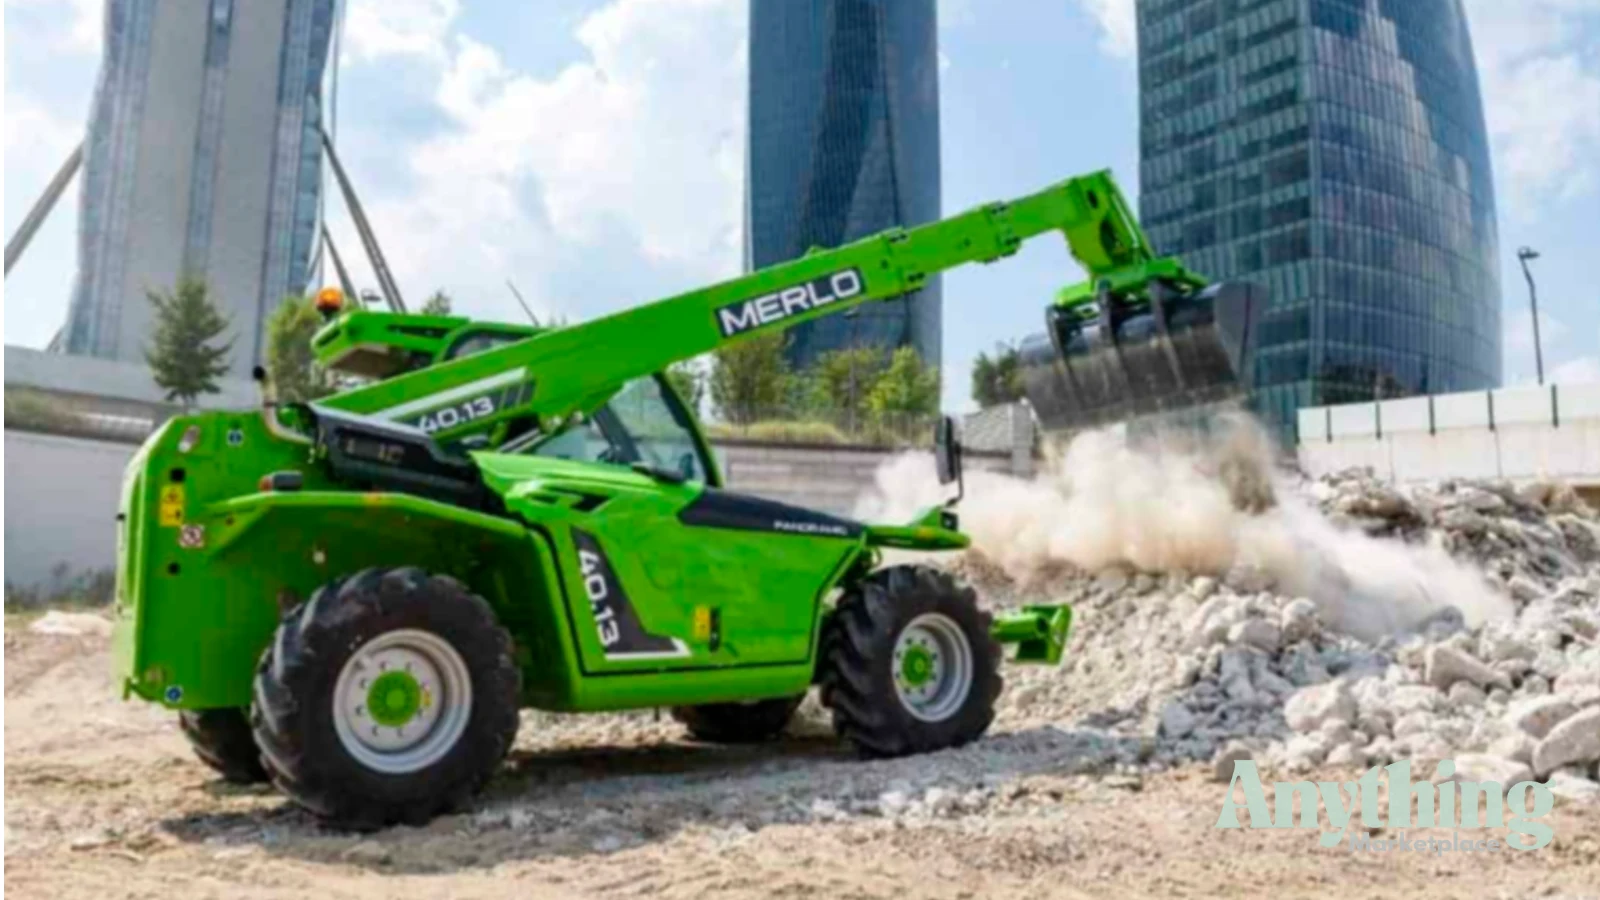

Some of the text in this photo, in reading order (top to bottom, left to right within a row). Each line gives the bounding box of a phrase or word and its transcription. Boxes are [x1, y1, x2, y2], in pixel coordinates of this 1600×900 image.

[719, 270, 861, 336] MERLO
[419, 396, 494, 434] 40.13
[578, 550, 620, 646] 40.13
